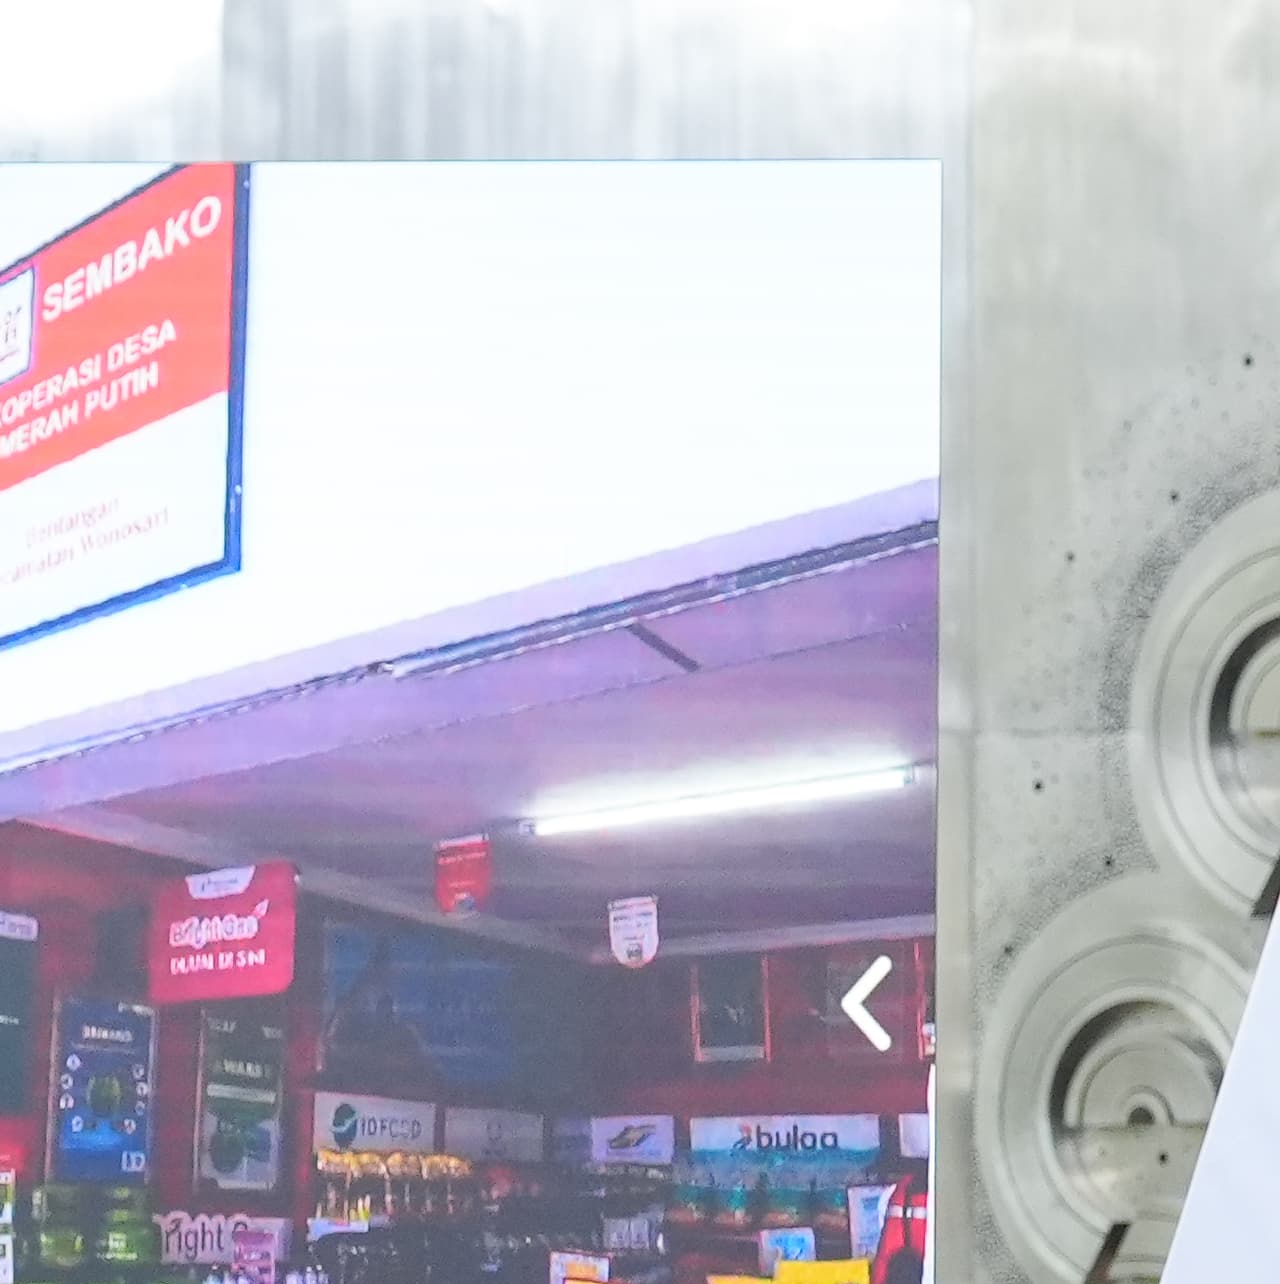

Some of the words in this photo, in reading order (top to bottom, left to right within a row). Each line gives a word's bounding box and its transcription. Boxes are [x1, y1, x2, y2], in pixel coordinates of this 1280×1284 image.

[42, 196, 221, 322] SEMBAKO
[107, 319, 177, 372] DESA
[84, 362, 158, 418] PUTIH
